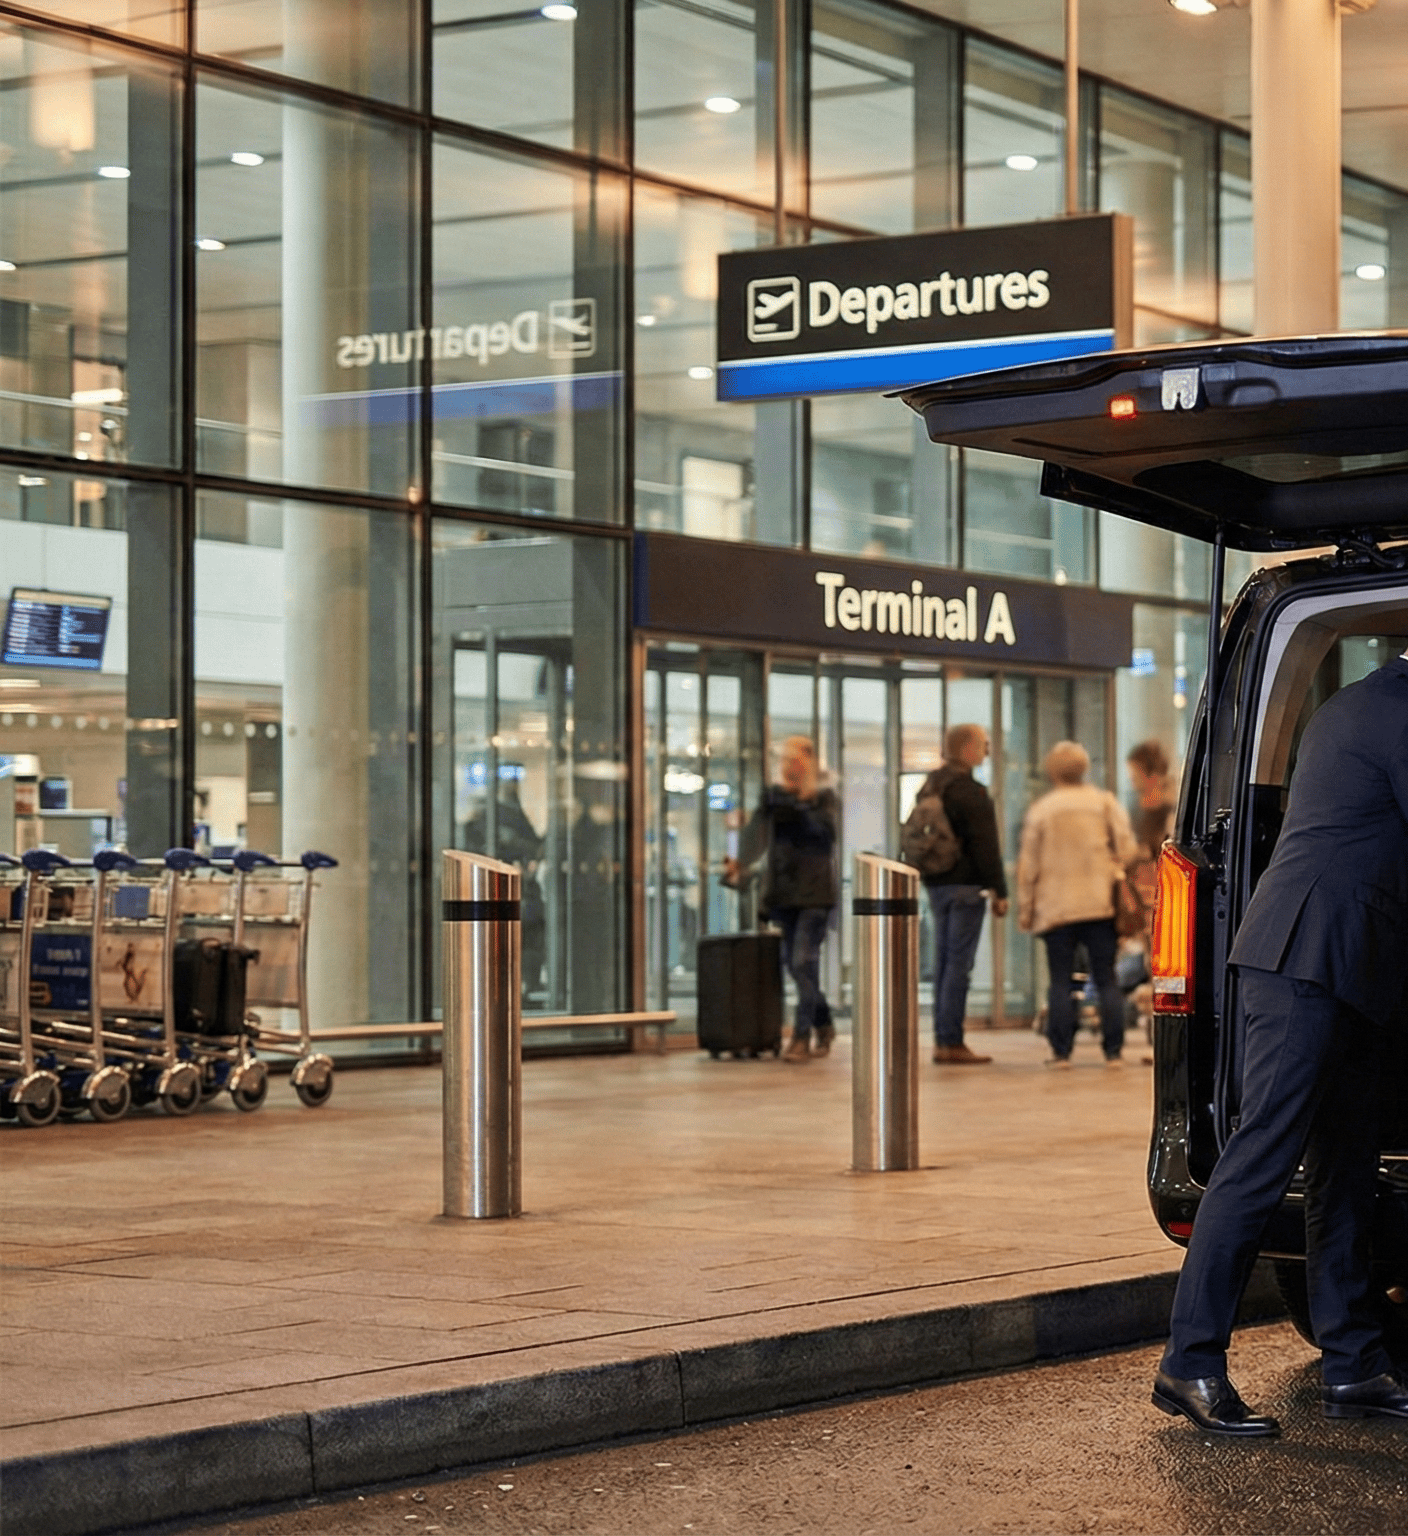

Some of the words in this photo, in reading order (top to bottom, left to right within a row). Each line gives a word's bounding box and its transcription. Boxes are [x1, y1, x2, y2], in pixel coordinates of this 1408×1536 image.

[808, 269, 1050, 334] Departures
[815, 571, 977, 642] Terminal
[983, 591, 1016, 646] A
